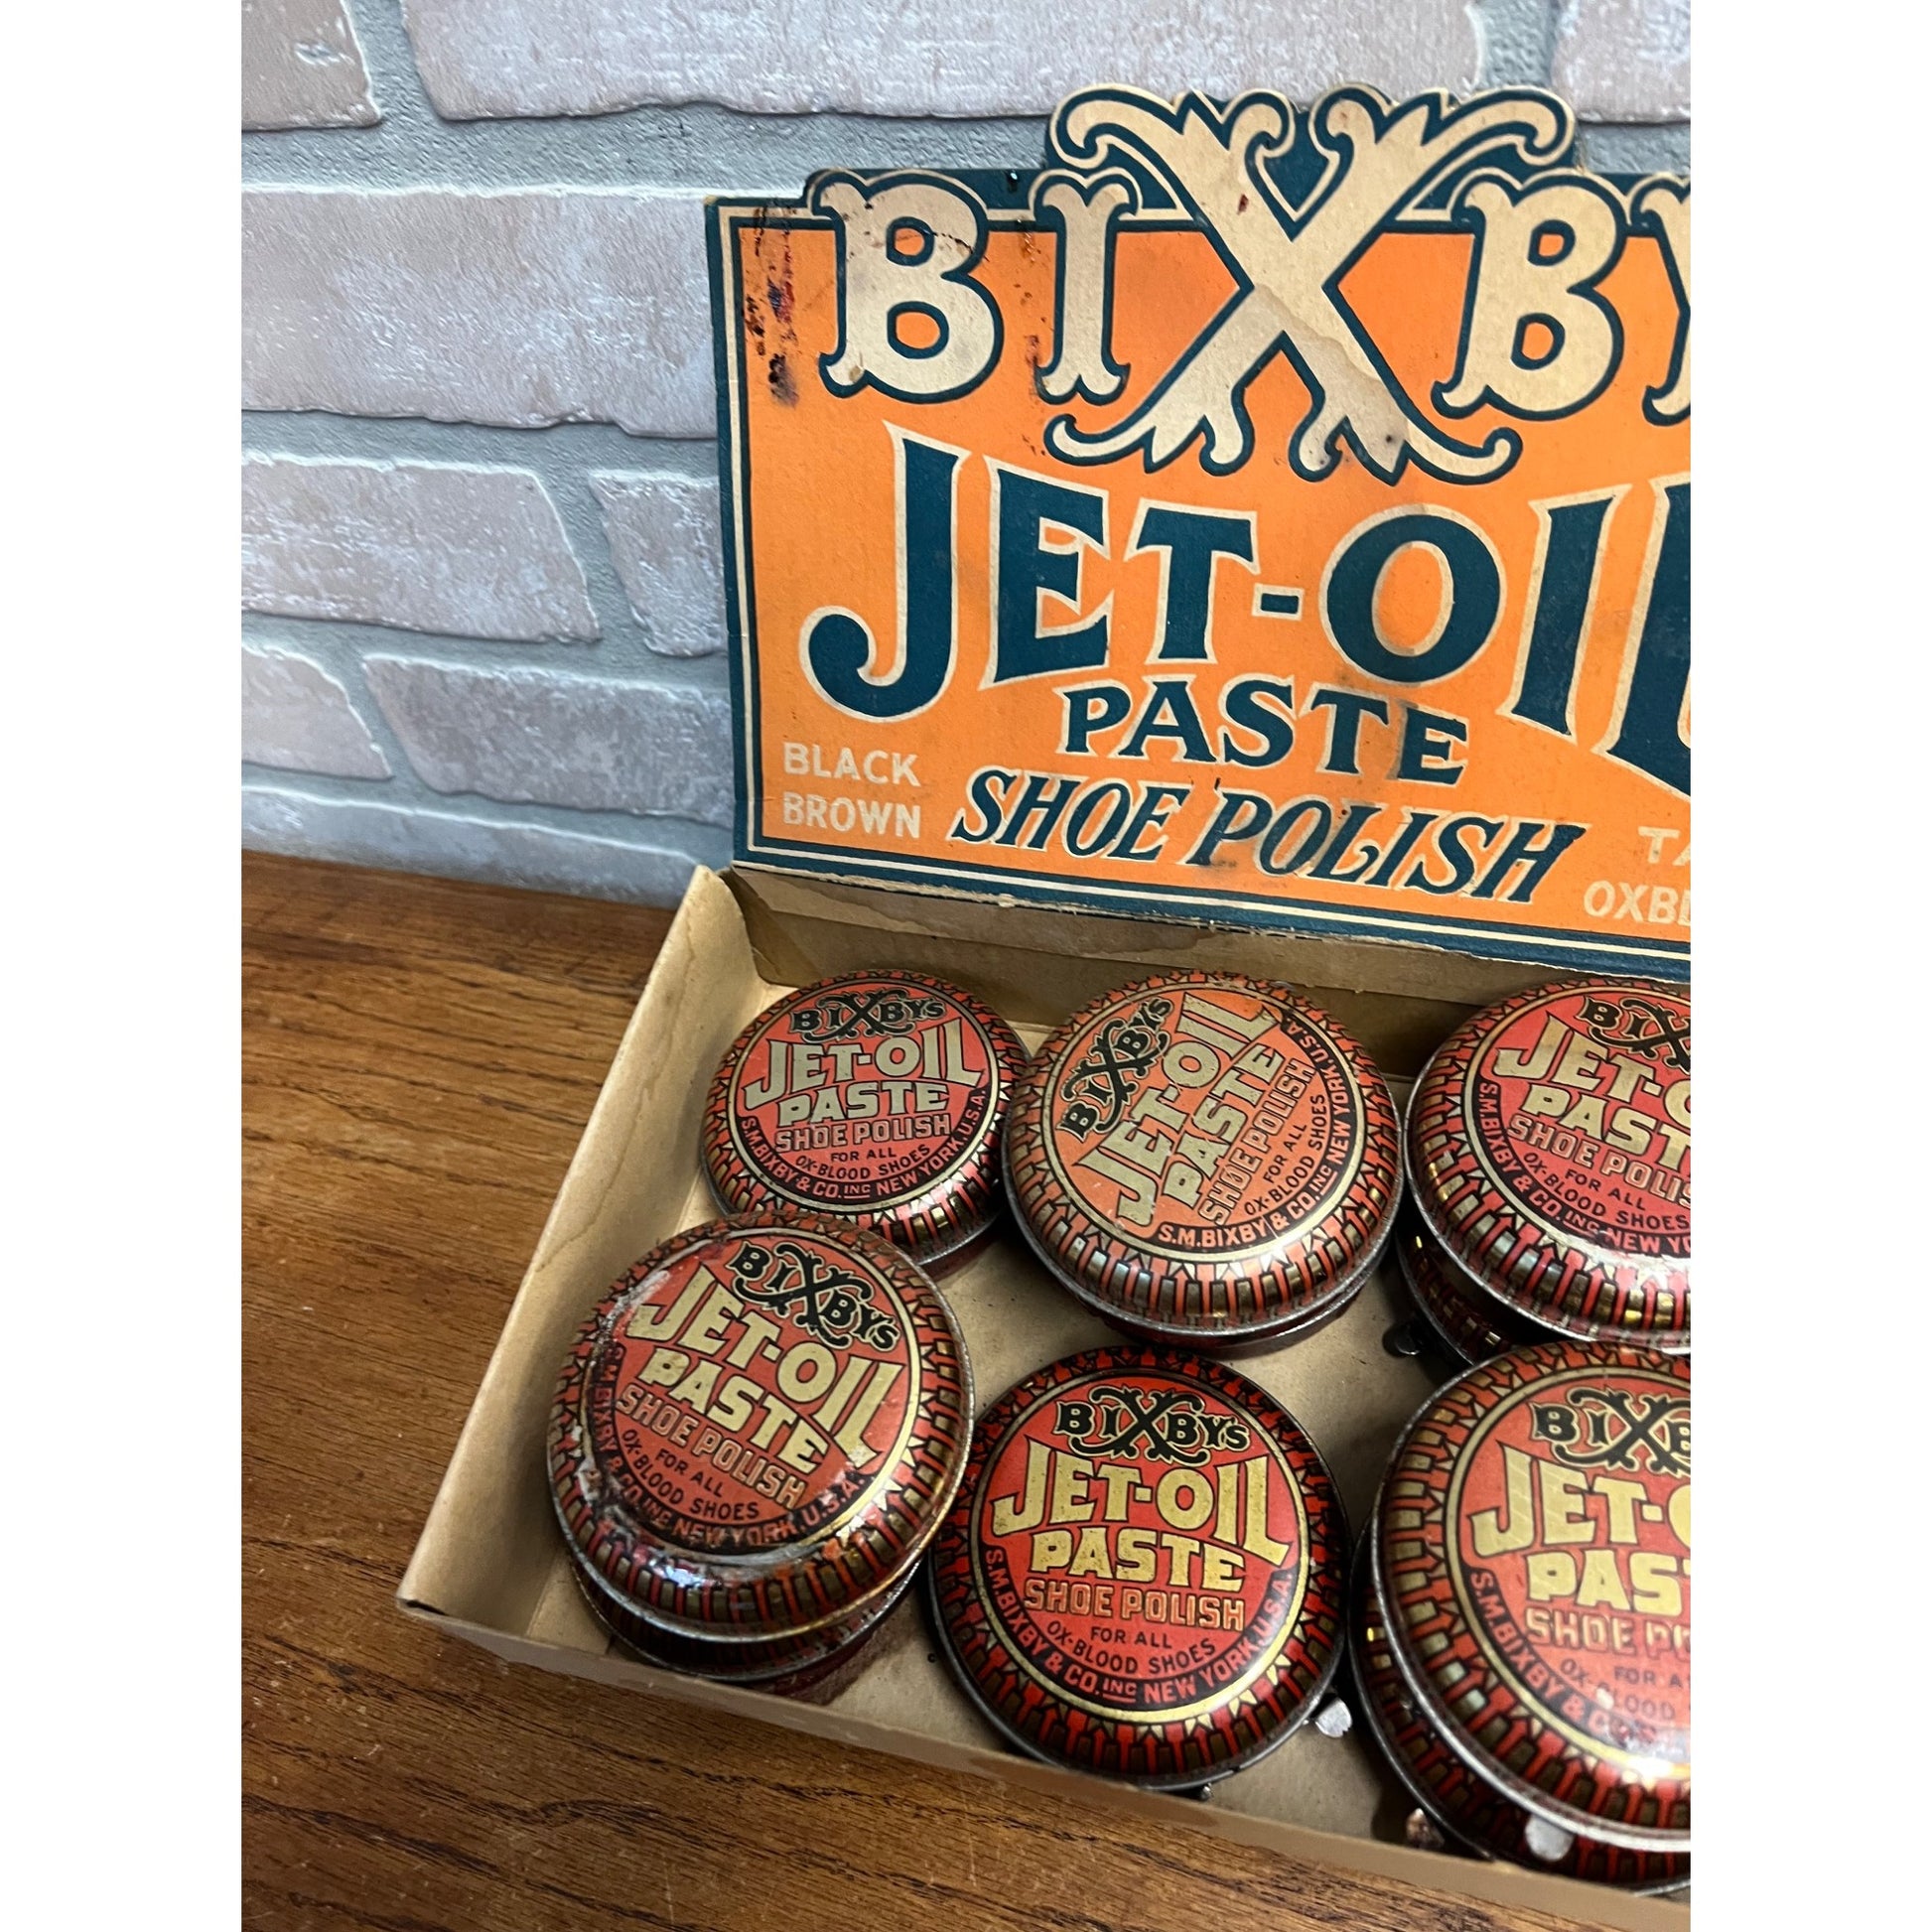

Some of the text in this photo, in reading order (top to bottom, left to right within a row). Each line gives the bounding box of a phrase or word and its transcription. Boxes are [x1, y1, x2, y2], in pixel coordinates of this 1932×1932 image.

[1057, 676, 1468, 786] PASTE
[783, 743, 921, 788] BLACK
[782, 791, 922, 840] BROWN
[949, 769, 1592, 904] SHOE POLISH
[743, 1018, 985, 1110] JET-OIL
[775, 1113, 952, 1153] SHOE POLISH
[776, 1081, 949, 1127] PASTE
[1072, 992, 1283, 1227] JET-OIL
[1163, 1042, 1286, 1210] PASTE
[795, 1145, 930, 1180] OX-BLOOD SHOES
[830, 1148, 897, 1163] FOR ALL
[1197, 1057, 1319, 1226] SHOE POLISH
[1243, 1093, 1327, 1216] OX-BLOOD SHOES
[1263, 1121, 1308, 1183] FOR ALL
[1507, 1114, 1600, 1170] SHOE
[796, 1176, 811, 1191] &
[876, 1169, 919, 1195] NEW
[1271, 1213, 1291, 1232] &
[1326, 1120, 1352, 1166] NEW
[1524, 1152, 1690, 1230] OX-BLOOD SHOES
[1565, 1169, 1646, 1211] FOR ALL
[1512, 1174, 1533, 1192] &
[1605, 1227, 1661, 1254] NEW
[626, 1263, 904, 1468] JET-OIL
[637, 1345, 830, 1474] PASTE
[617, 1383, 806, 1510] SHOE POLISH
[621, 1428, 759, 1520] OX-BLOOD SHOES
[655, 1448, 723, 1498] FOR ALL
[992, 1435, 1293, 1568] JET-OIL
[1031, 1526, 1246, 1592] PASTE
[1525, 1549, 1690, 1616] PAS
[1024, 1578, 1245, 1632] SHOE POLISH
[1525, 1607, 1637, 1654] SHOE
[1046, 1619, 1216, 1676] OX-BLOOD SHOES
[1091, 1627, 1173, 1649] FOR ALL
[1044, 1652, 1064, 1673] &
[1144, 1674, 1197, 1704] NEW
[1613, 1665, 1656, 1686] FOR
